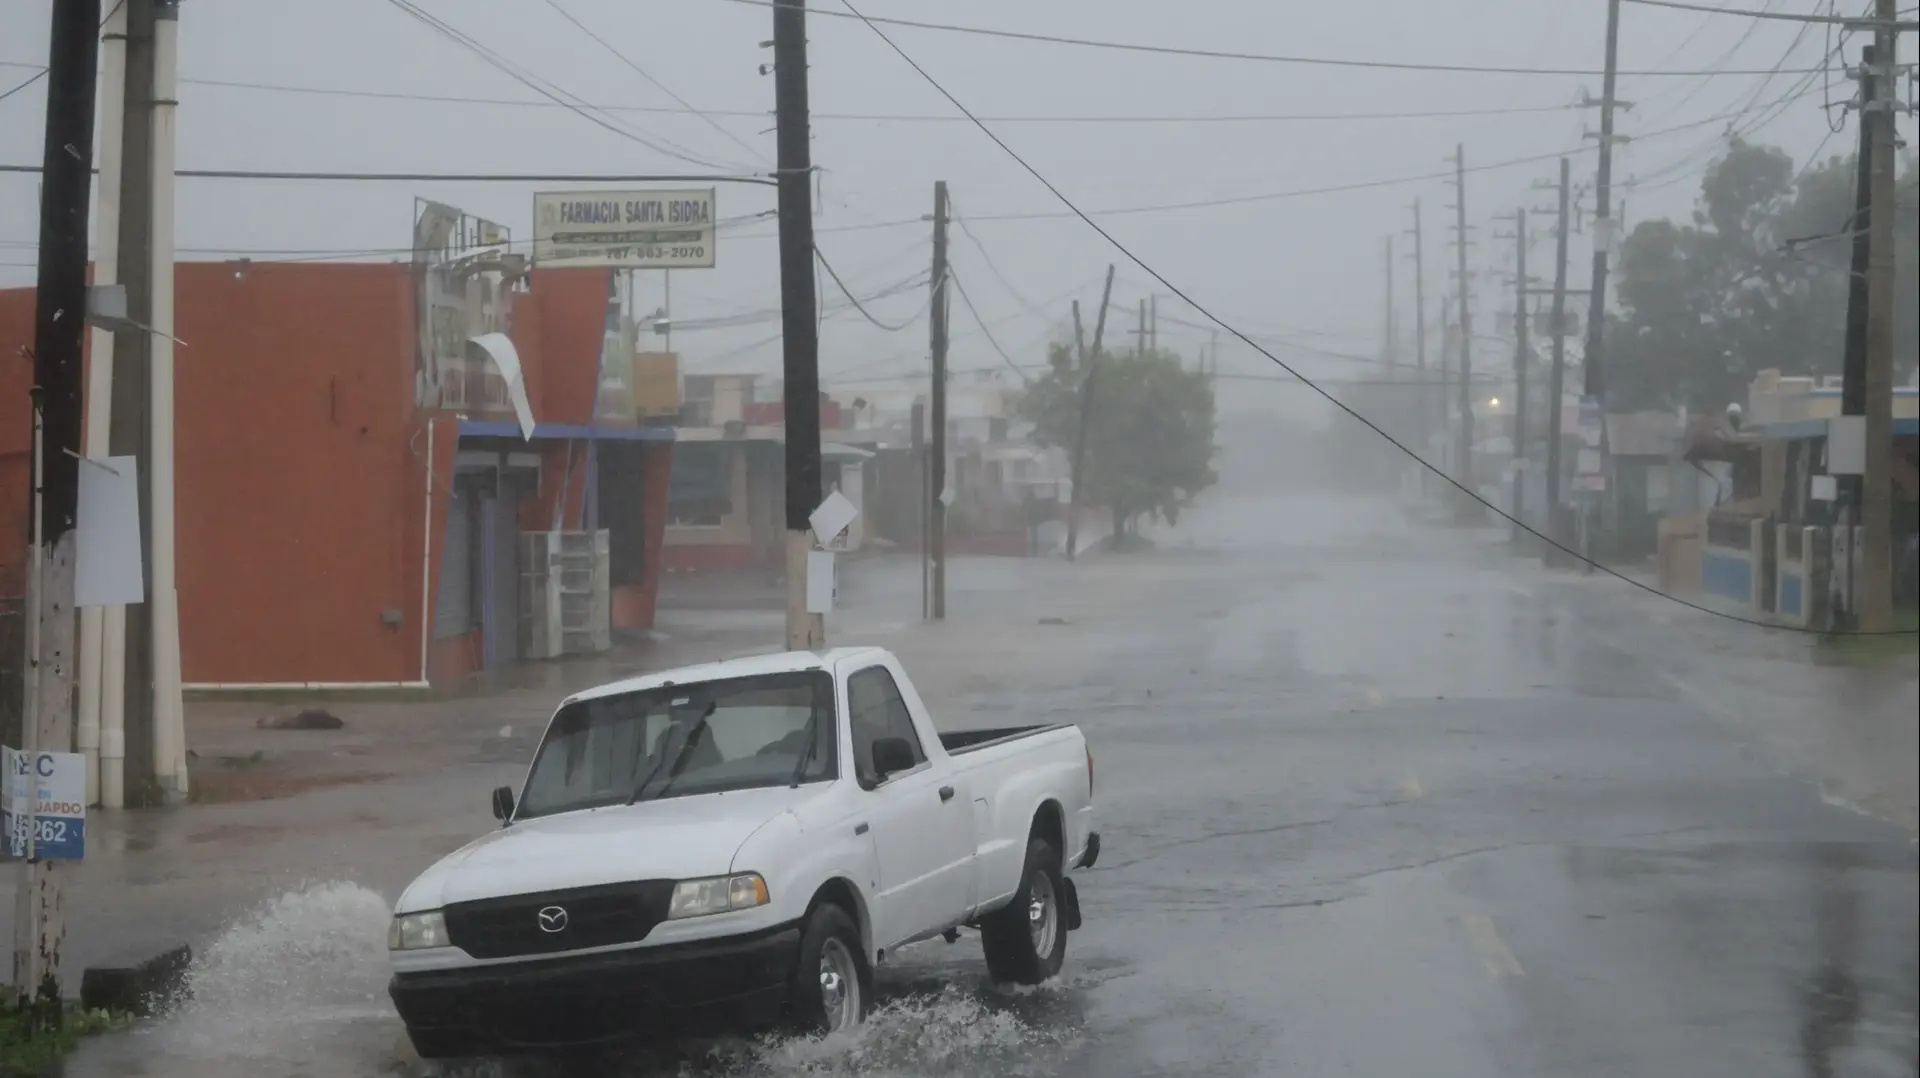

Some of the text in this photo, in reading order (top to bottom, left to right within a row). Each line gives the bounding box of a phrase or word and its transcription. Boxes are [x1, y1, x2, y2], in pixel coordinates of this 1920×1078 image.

[560, 199, 710, 224] FARMACIA SANTA ISIDRA
